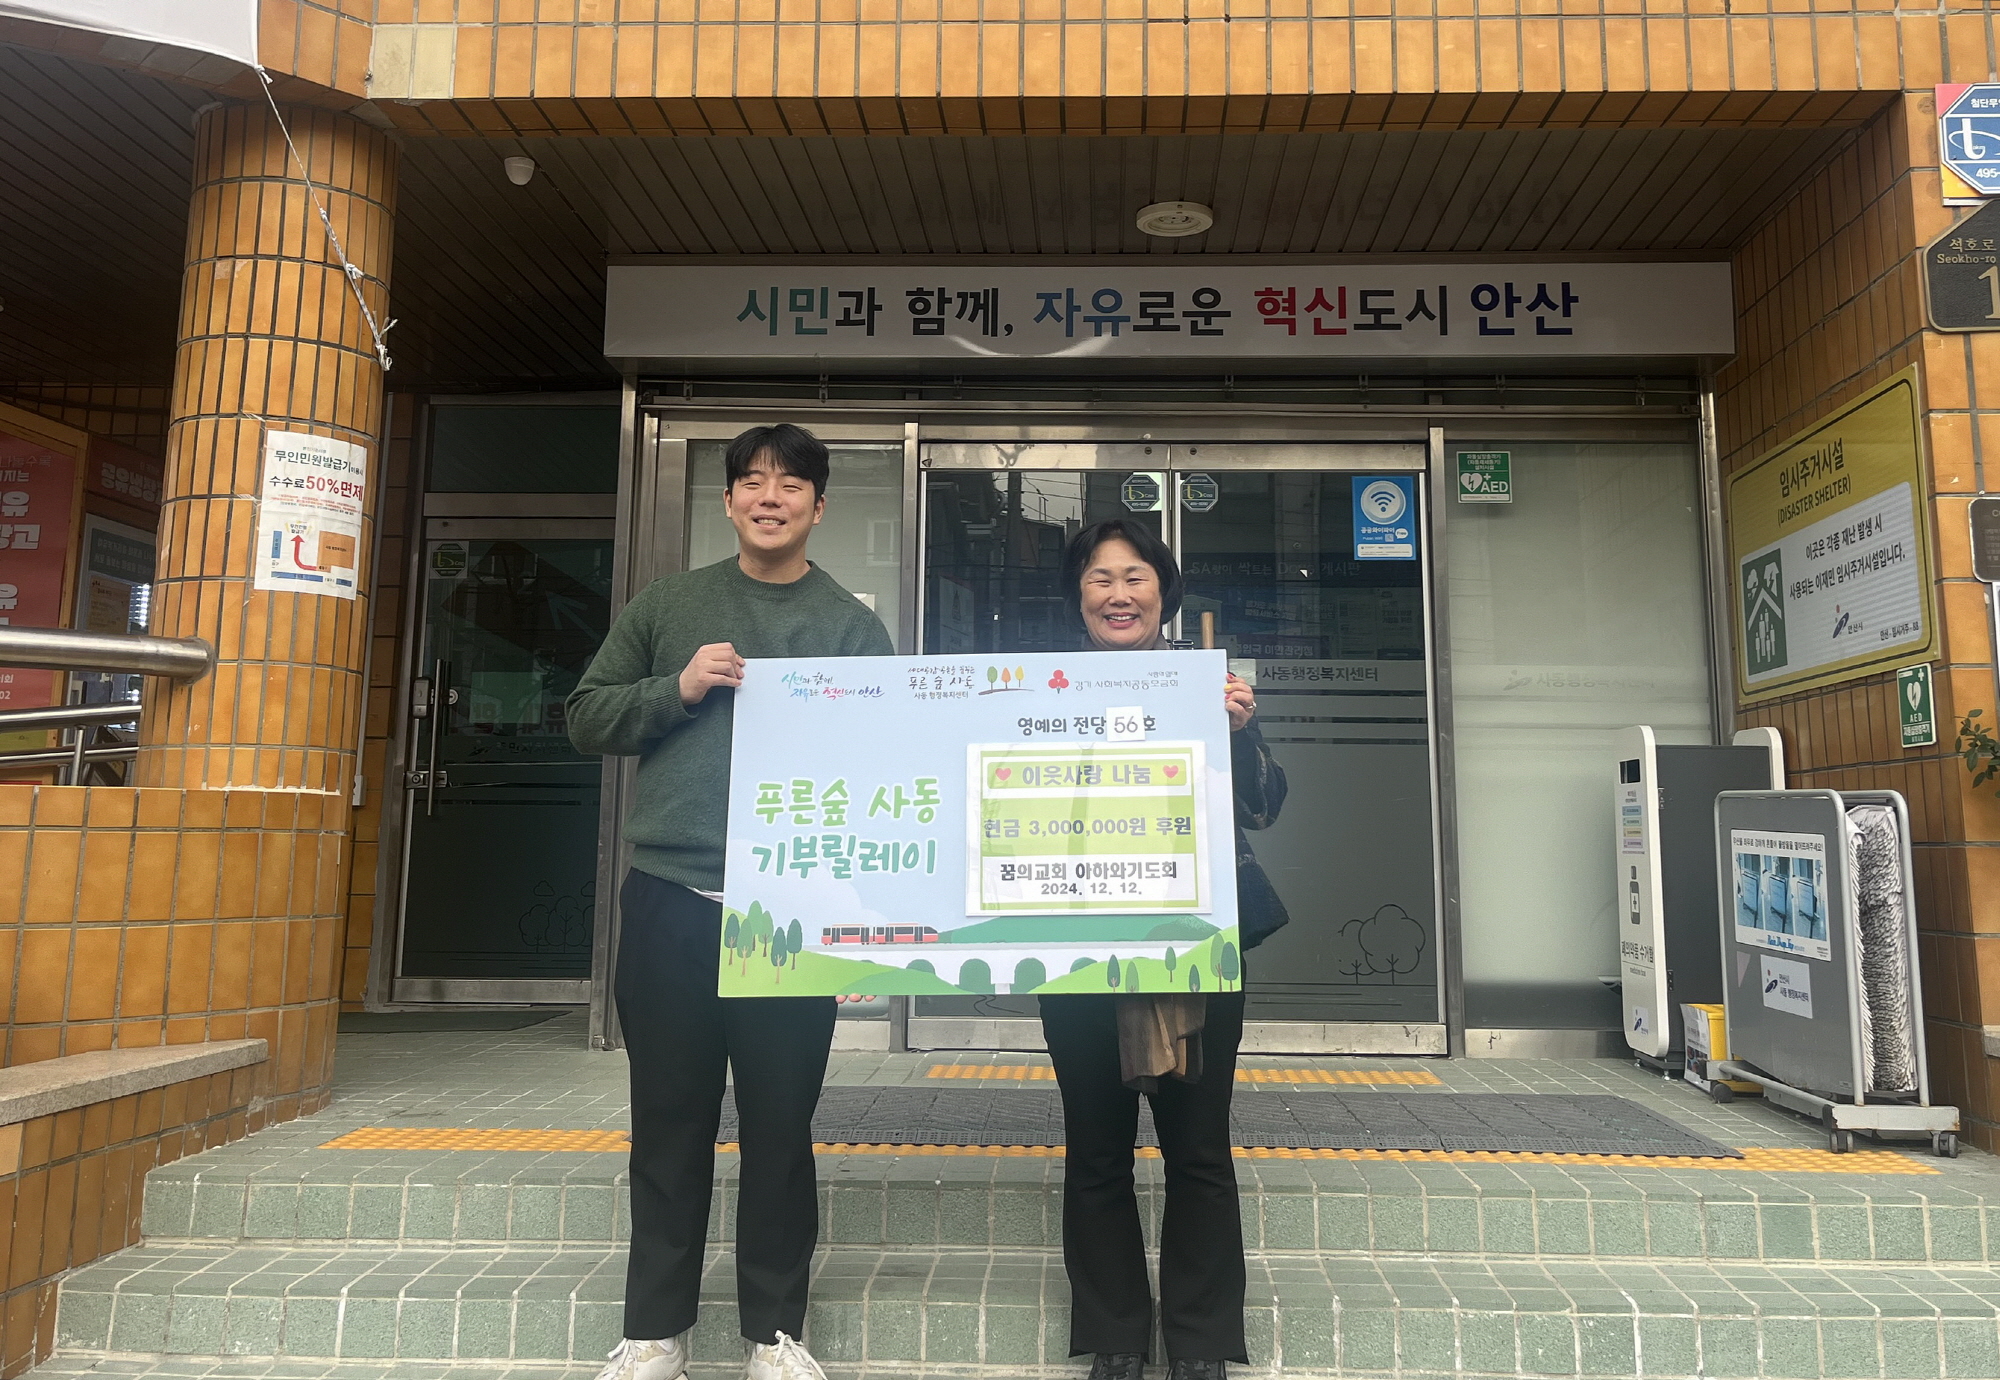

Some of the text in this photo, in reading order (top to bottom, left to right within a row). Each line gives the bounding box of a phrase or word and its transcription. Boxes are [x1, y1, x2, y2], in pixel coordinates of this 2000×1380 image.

[1971, 98, 2000, 108] 첨단무
[1949, 238, 1997, 251] 석호로
[1937, 253, 1997, 264] Seokho-ro
[737, 281, 1580, 337] 시민과 함께, 자유로운 혁신도시 안산
[274, 450, 351, 473] 무인민원발급기
[1779, 437, 1844, 499] 임시주거시설
[0, 470, 30, 482] 지는
[1480, 481, 1508, 493] AED
[1777, 473, 1851, 528] (DISASTER SHELTER)
[1805, 513, 1883, 561] 이곳은 각종 재난 발생 시
[1321, 561, 1361, 577] 게시판
[1789, 542, 1906, 600] 사용되는 이재민 임시주거시설입니다.
[909, 676, 975, 690] 푸른 숲 사동
[1262, 666, 1378, 683] 사동행정복지센터
[858, 686, 885, 698] 안산
[1017, 717, 1067, 736] 영예의
[1073, 716, 1106, 735] 전당
[1113, 715, 1138, 734] 56
[1909, 712, 1923, 723] AED
[1022, 764, 1151, 786] 이웃사랑 나눔
[755, 777, 941, 827] 푸른숲 사동
[984, 816, 1192, 838] 현금 3,000,000원 후원
[751, 834, 936, 879] 기부릴레이
[1000, 861, 1177, 881] 꿈의교회 아하와기도회
[1041, 882, 1142, 896] 2024. 12. 12.
